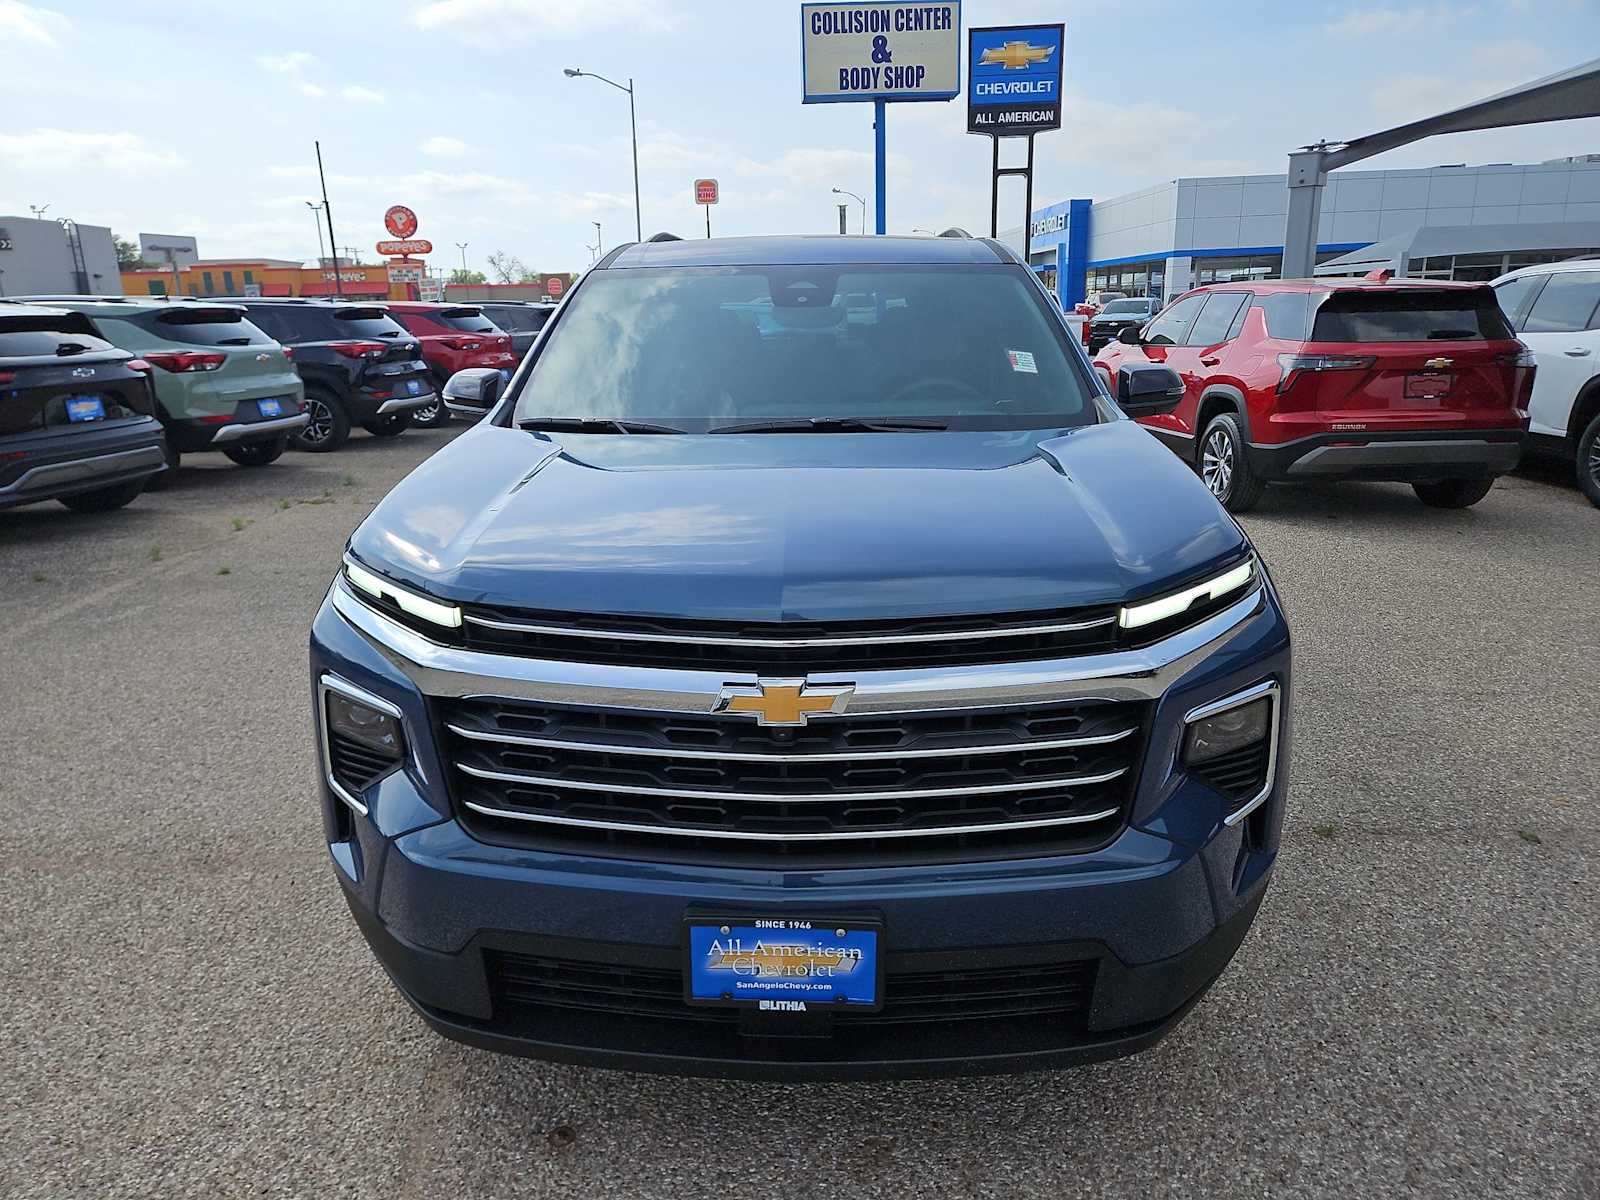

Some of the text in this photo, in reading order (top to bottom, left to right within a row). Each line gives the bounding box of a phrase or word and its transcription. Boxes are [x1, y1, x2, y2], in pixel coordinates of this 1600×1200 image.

[811, 7, 952, 35] COLLISION CENTER
[871, 34, 893, 64] &
[839, 65, 925, 90] BODY SHOP
[976, 80, 1053, 95] CHEVROLET
[975, 110, 1054, 124] ALL AMERICAN
[1033, 213, 1069, 237] CHEVROLET
[755, 920, 812, 930] SINCE 1946
[707, 938, 864, 960] All American
[732, 957, 836, 977] Chevrolet
[736, 981, 833, 991] SanAngeloChevy.com
[769, 1000, 807, 1012] LITHIA
